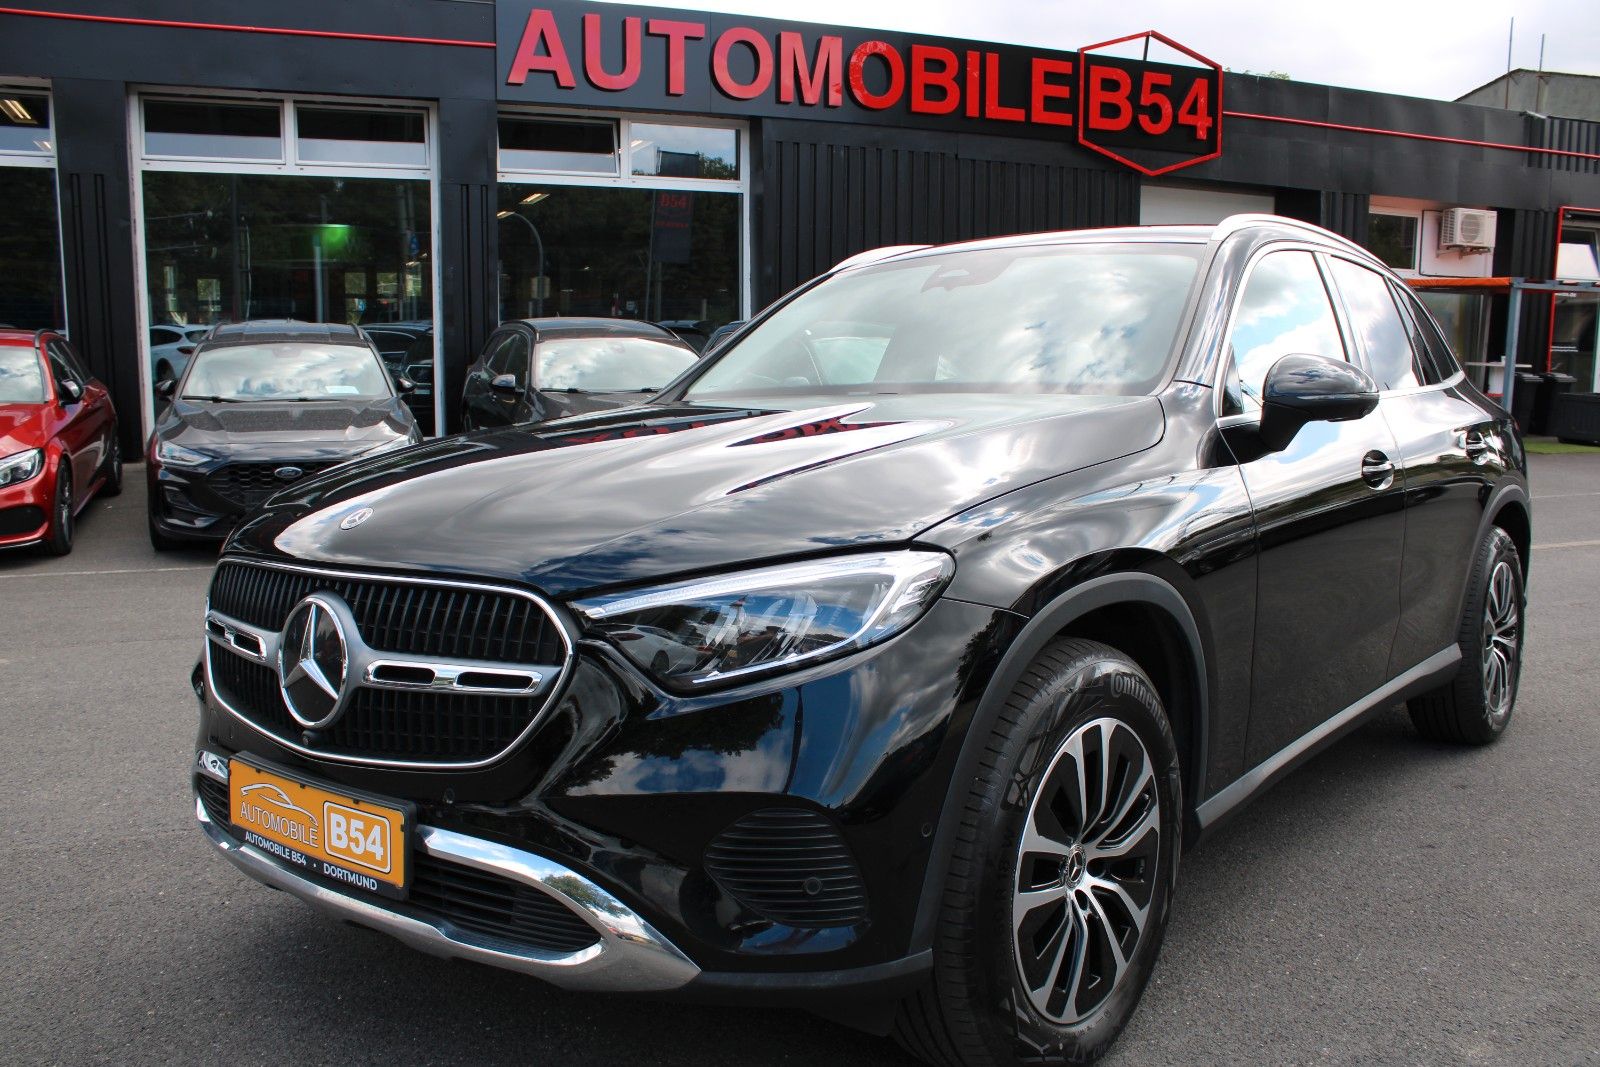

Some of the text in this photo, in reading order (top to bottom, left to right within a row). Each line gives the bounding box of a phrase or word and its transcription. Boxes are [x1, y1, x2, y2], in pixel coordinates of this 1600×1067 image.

[507, 9, 1213, 140] AUTOMOBILE B54
[240, 801, 384, 861] AUTOMOBILE B54
[245, 831, 378, 892] AUTOMOBILE B54 DORTMUND
